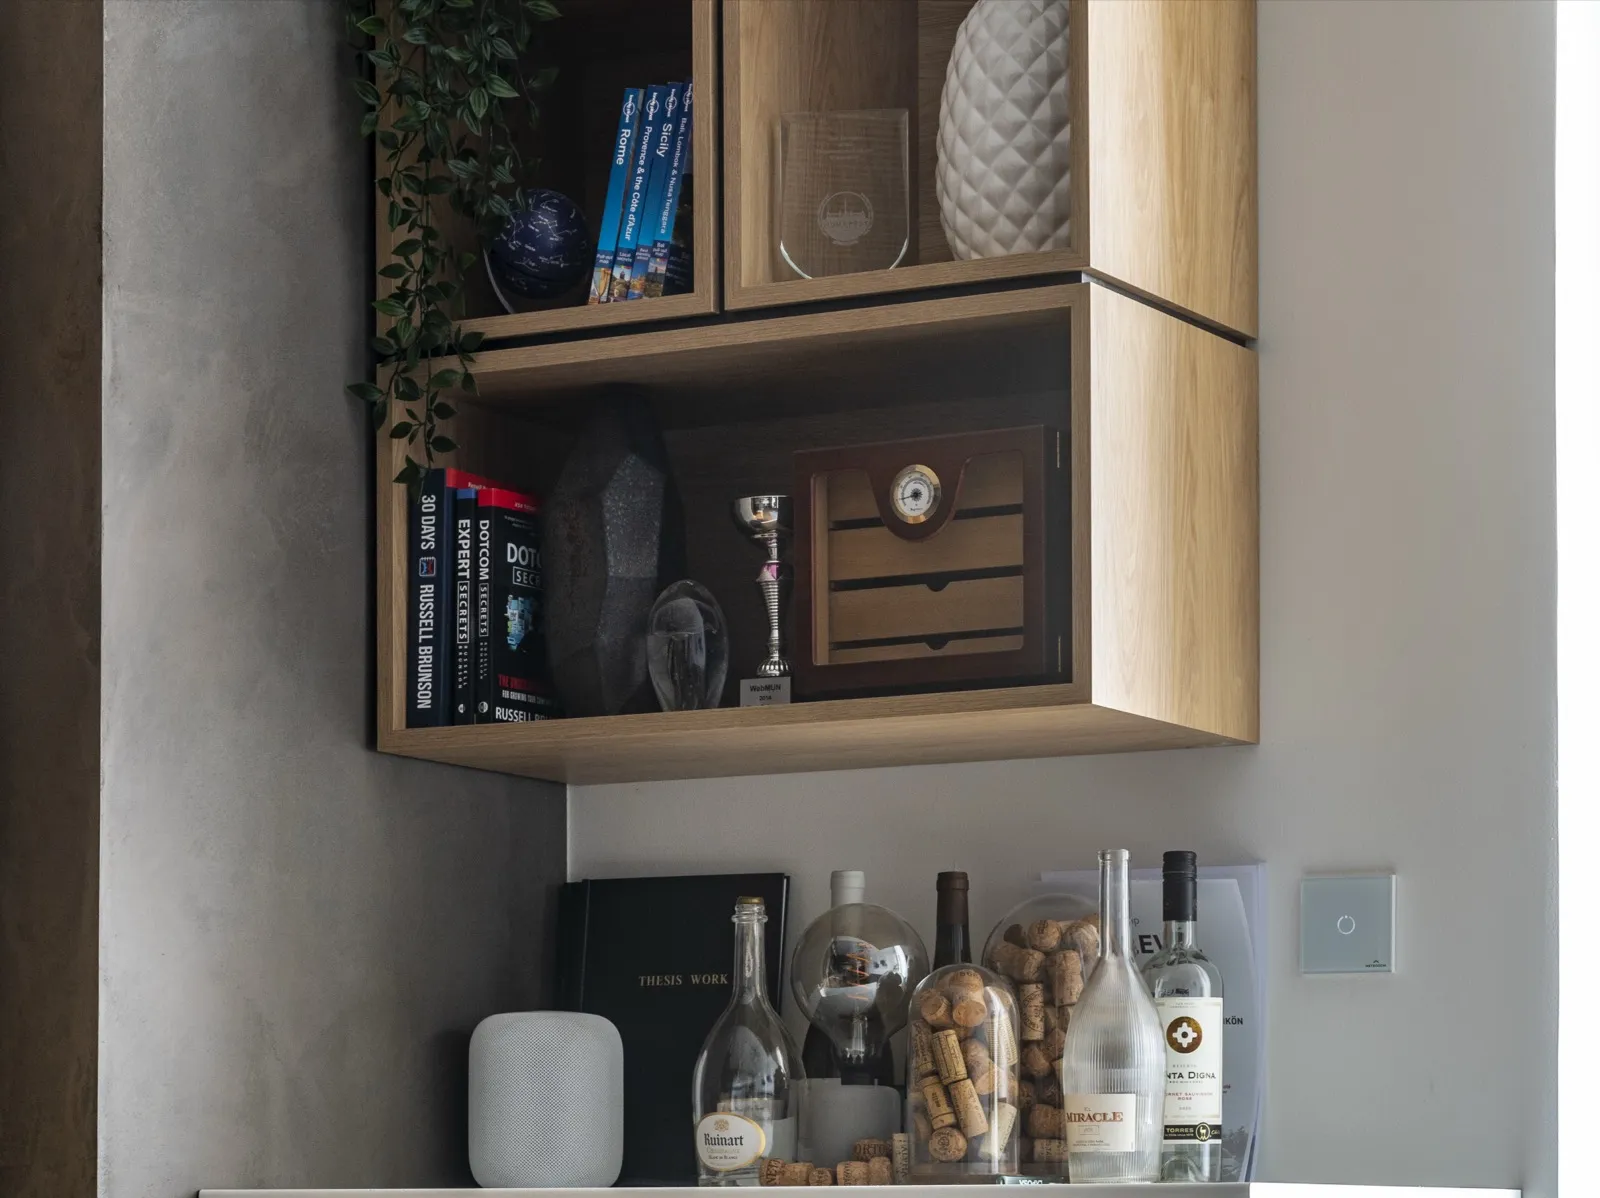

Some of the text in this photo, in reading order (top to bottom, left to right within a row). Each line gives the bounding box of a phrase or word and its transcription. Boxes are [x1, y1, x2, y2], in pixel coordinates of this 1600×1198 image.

[616, 128, 632, 166] Rome
[656, 123, 673, 158] Sicily
[672, 136, 684, 168] Lombok
[625, 126, 653, 241] Provence & the Côte d'Azur
[667, 177, 677, 198] Nusa
[660, 198, 673, 234] Tenggara
[420, 494, 436, 550] 30 DAYS
[458, 519, 470, 640] EXPERT SECRETS
[479, 520, 490, 633] DOTCOM SECRETS
[416, 584, 434, 709] RUSSELL BRUNSON
[495, 706, 534, 722] RUSSELL
[638, 973, 729, 987] THESIS WORK
[1066, 1112, 1124, 1123] MIRACLE
[704, 1133, 744, 1146] Ruinart
